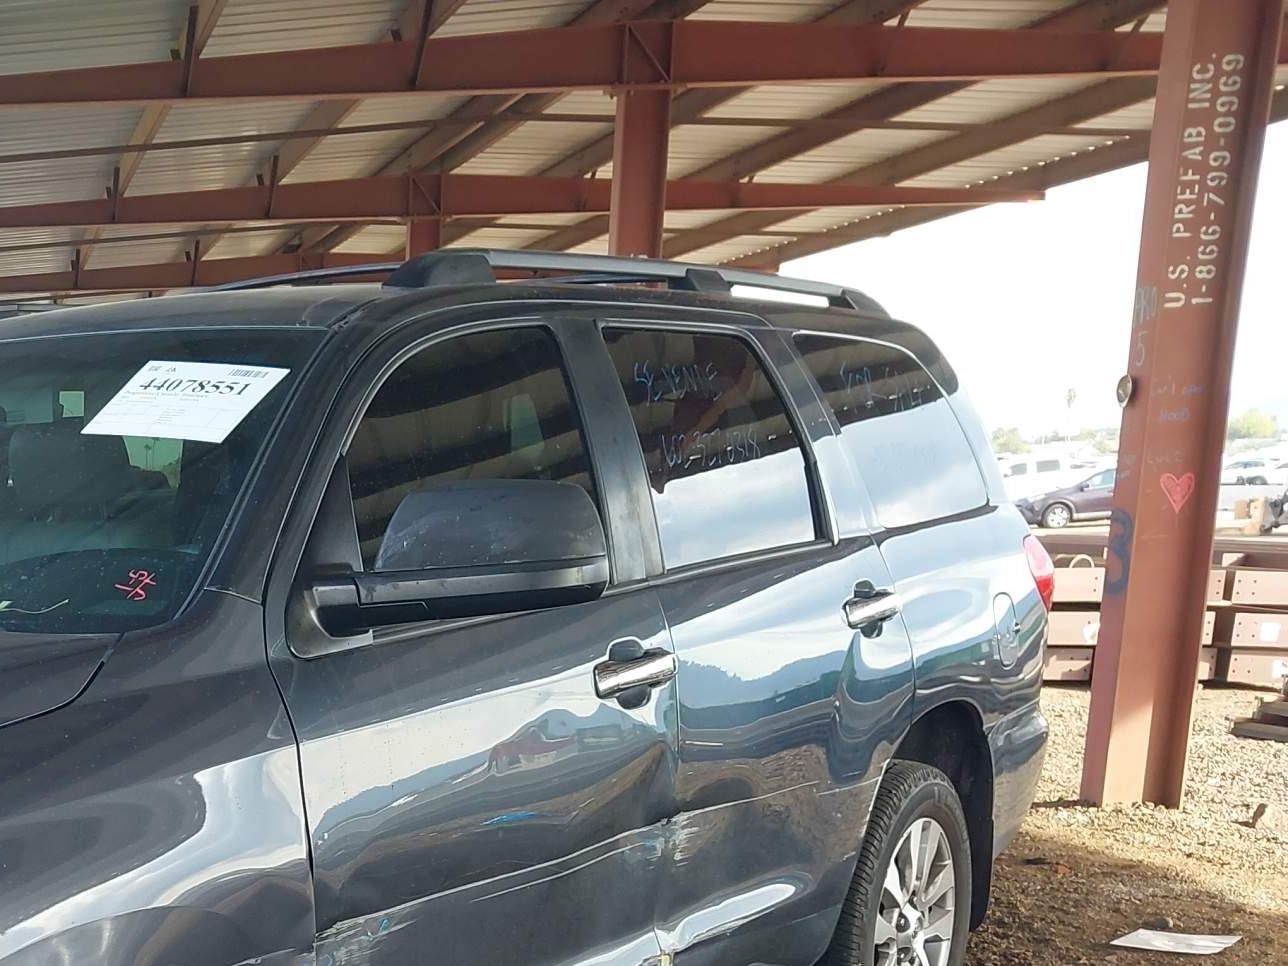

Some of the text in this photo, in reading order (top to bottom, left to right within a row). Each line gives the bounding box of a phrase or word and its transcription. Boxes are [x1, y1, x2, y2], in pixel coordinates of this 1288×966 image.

[1164, 53, 1217, 308] U.S. PREFAB INC.
[1191, 53, 1245, 306] 1-866-799-0969
[140, 378, 251, 395] 44078551
